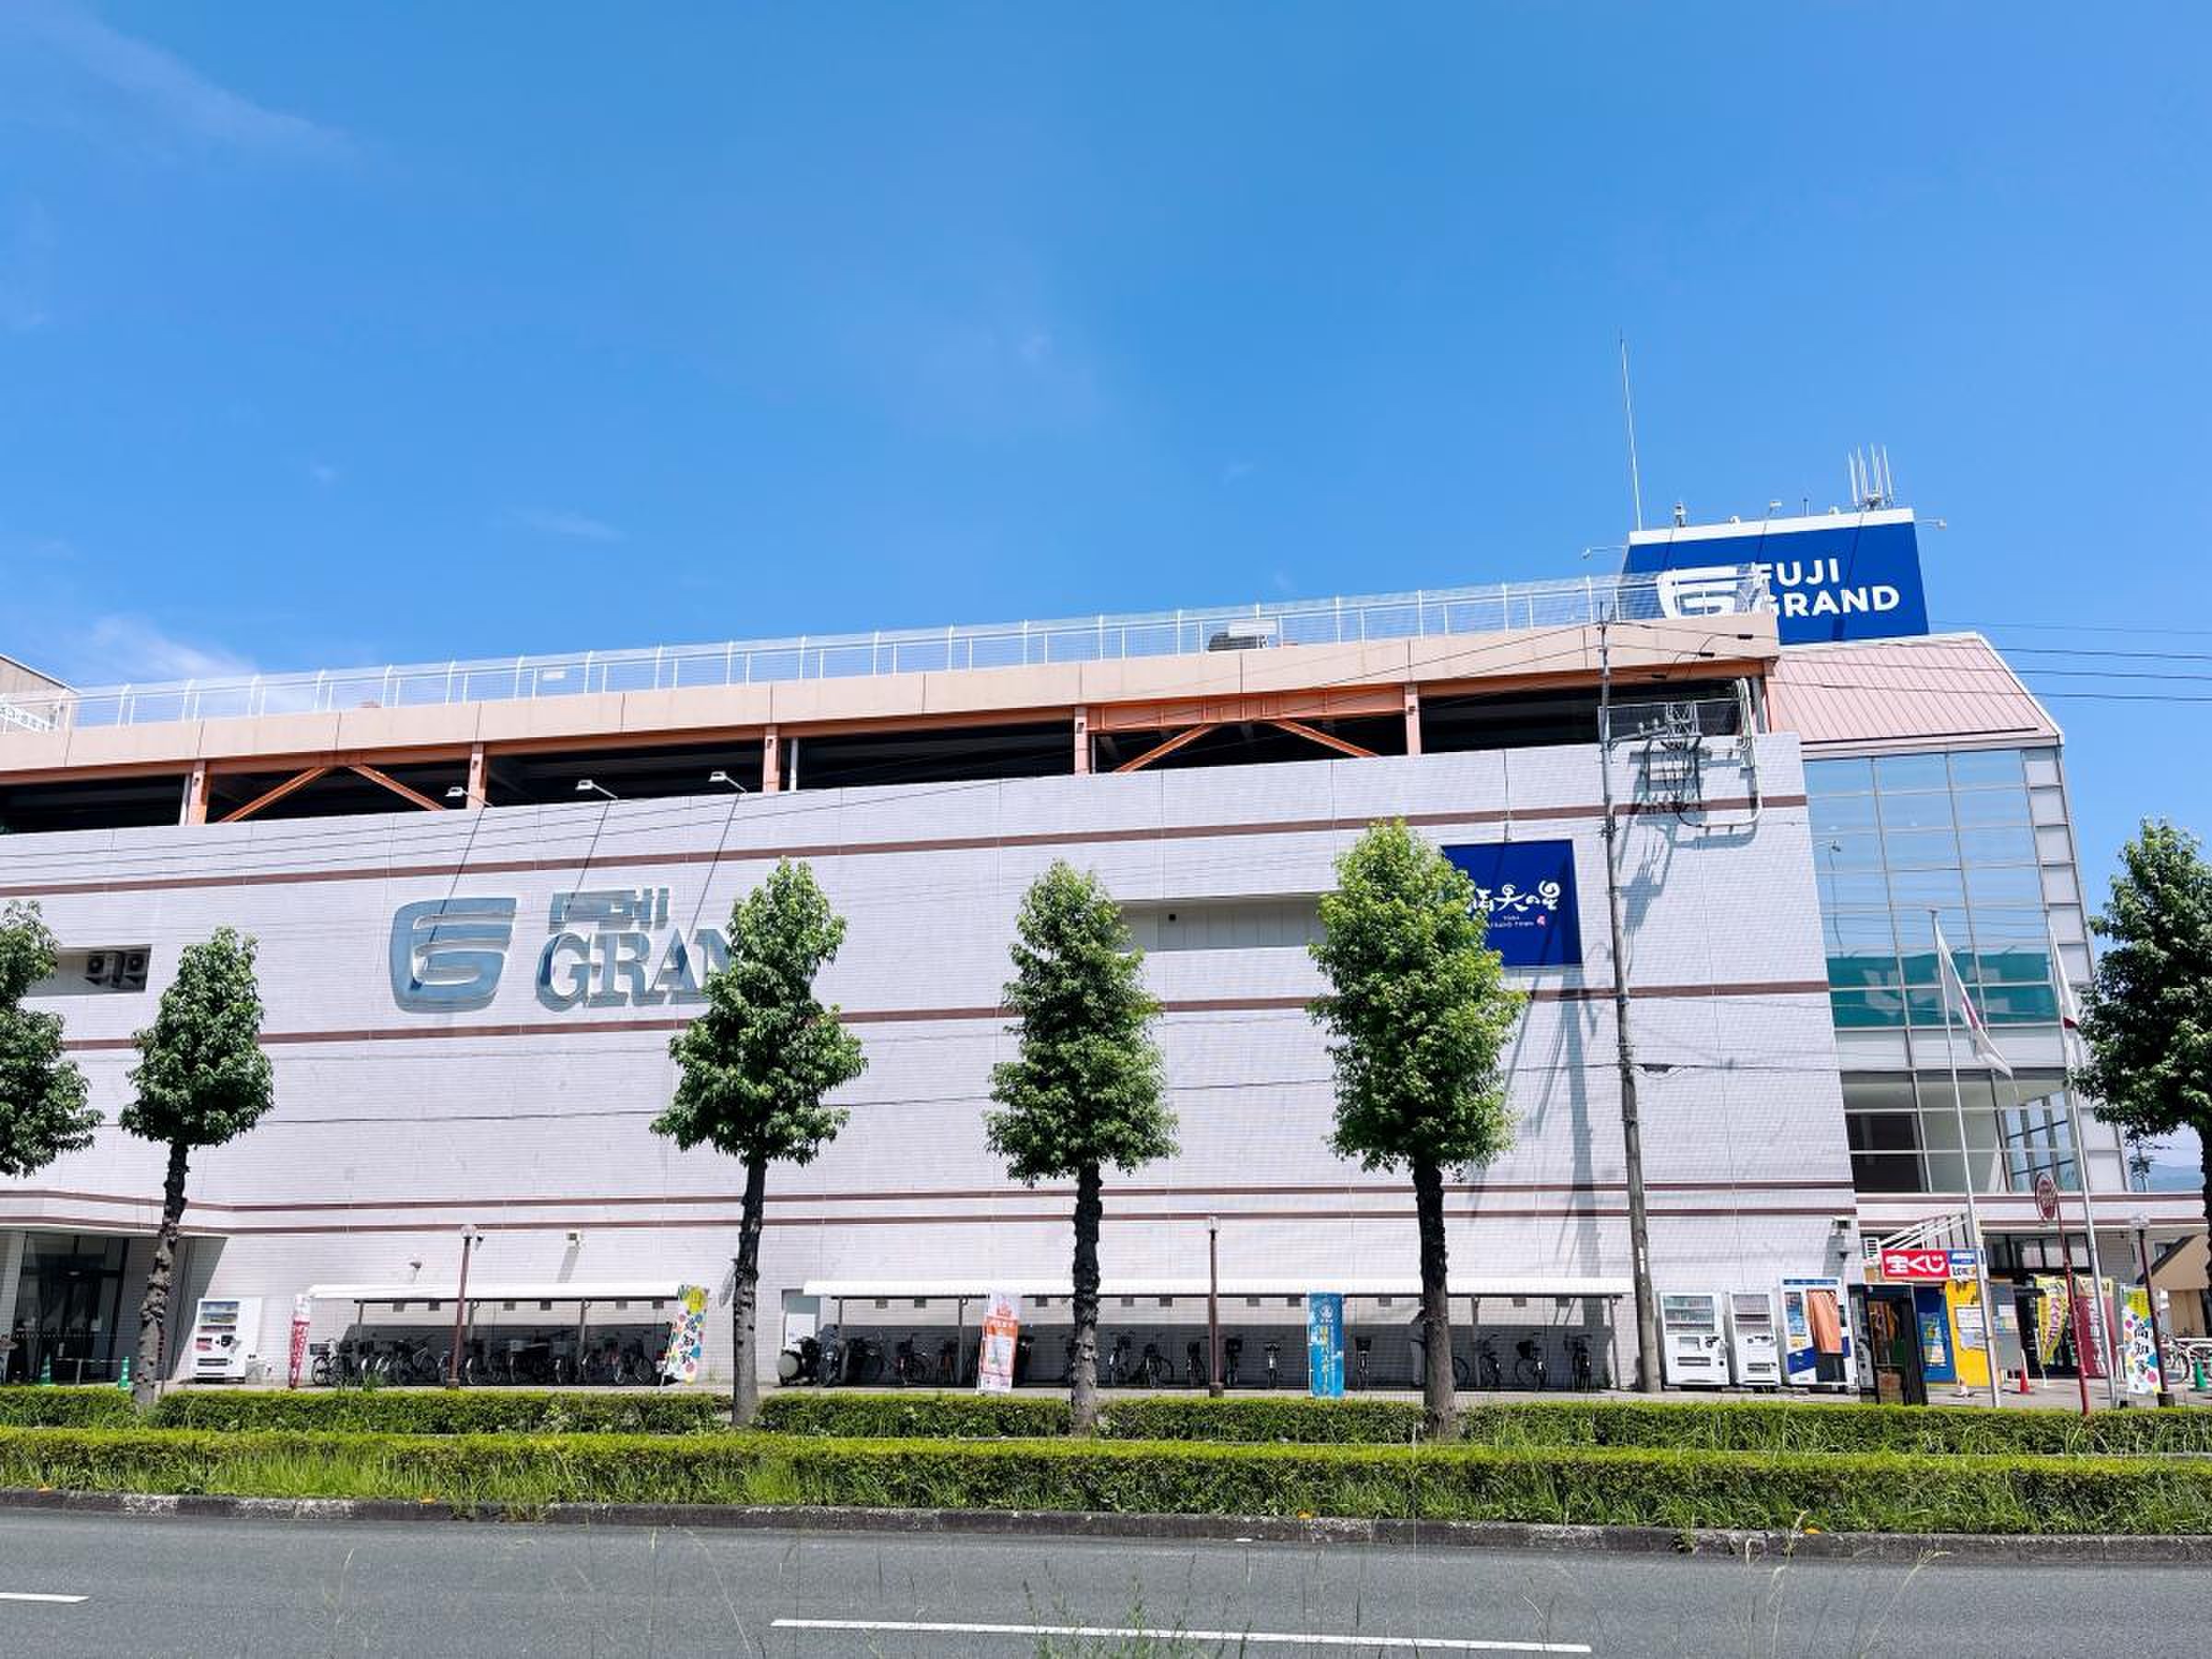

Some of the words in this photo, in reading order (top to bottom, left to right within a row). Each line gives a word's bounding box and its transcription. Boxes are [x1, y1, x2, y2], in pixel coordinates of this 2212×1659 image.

[1754, 558, 1840, 588] FUJI
[1753, 585, 1900, 618] GRAND
[535, 928, 734, 1012] GRAN
[1886, 1254, 1946, 1275] 宝くじ
